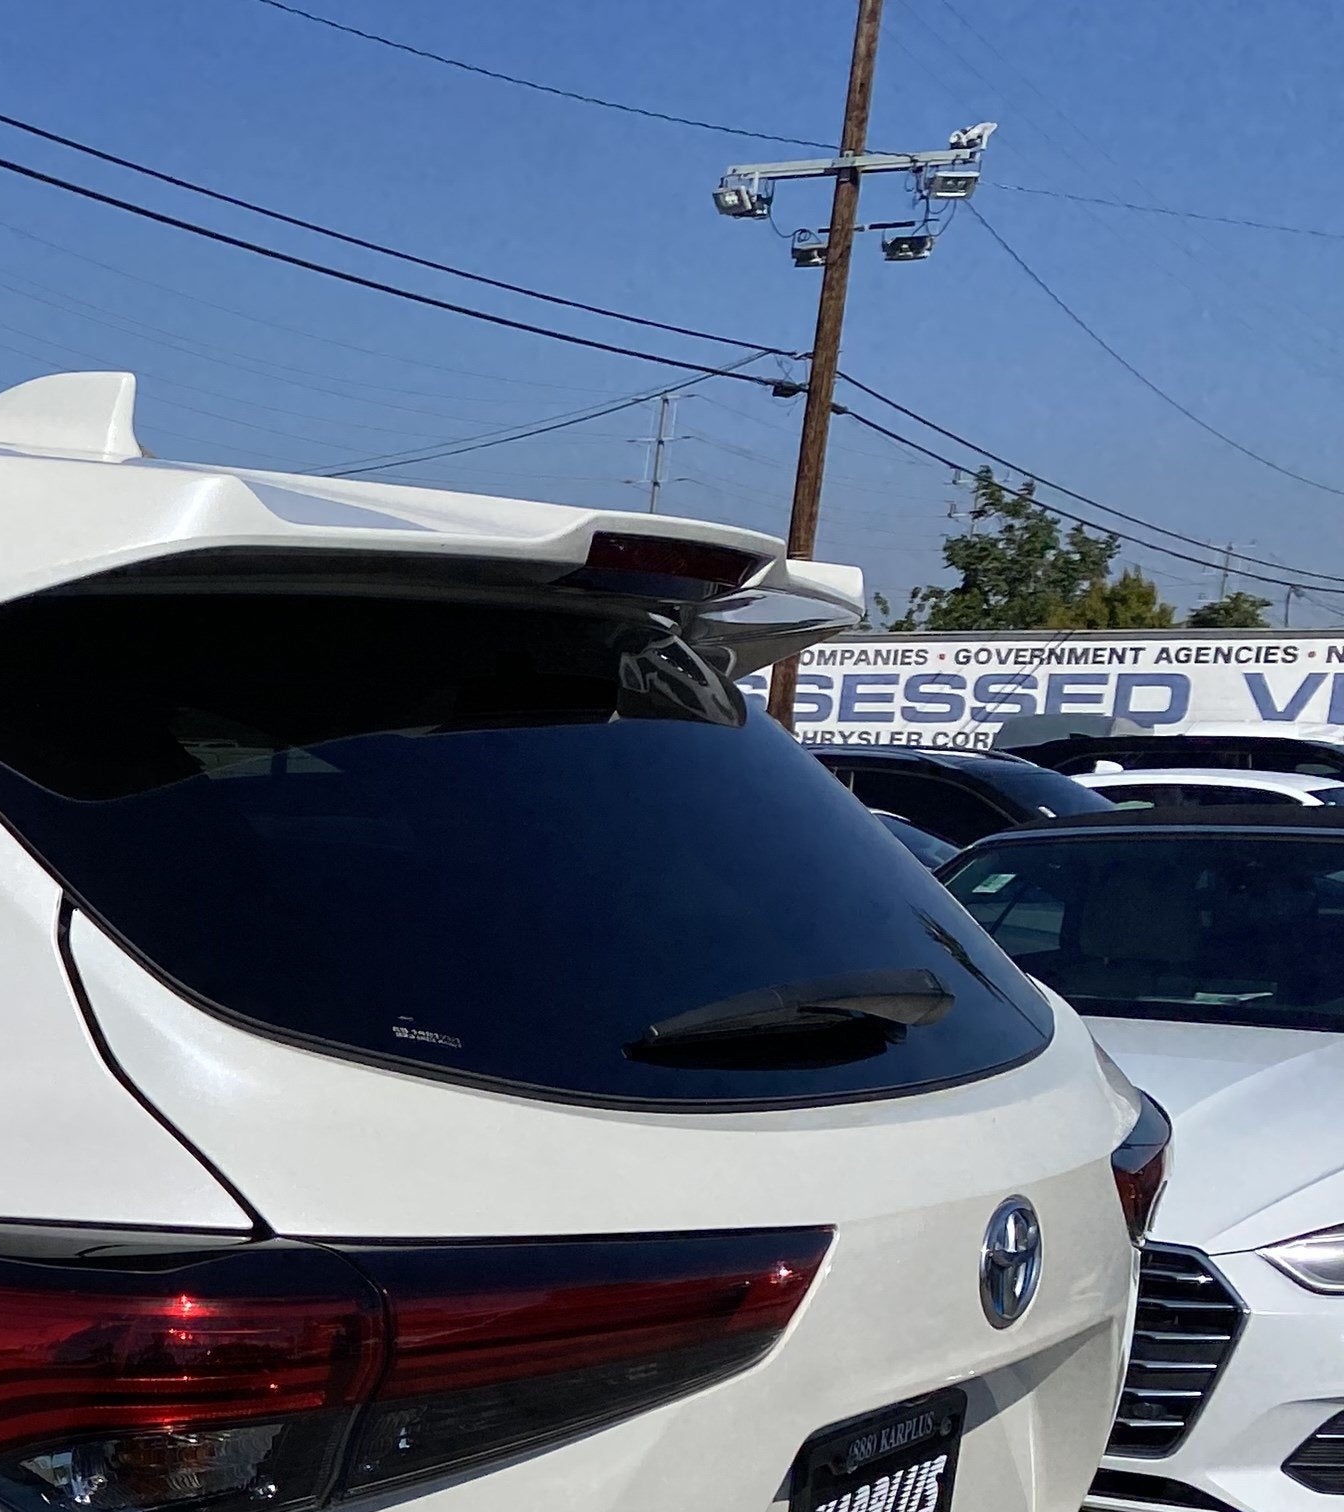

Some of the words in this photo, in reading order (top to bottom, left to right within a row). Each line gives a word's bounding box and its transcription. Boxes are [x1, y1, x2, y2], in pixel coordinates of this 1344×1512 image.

[800, 648, 929, 666] OMPANIES
[954, 646, 1145, 666] GOVERNMENT
[1153, 645, 1299, 664] AGENCIES
[1326, 646, 1344, 664] N
[932, 731, 996, 749] COR
[879, 1411, 935, 1453] KARPLUS
